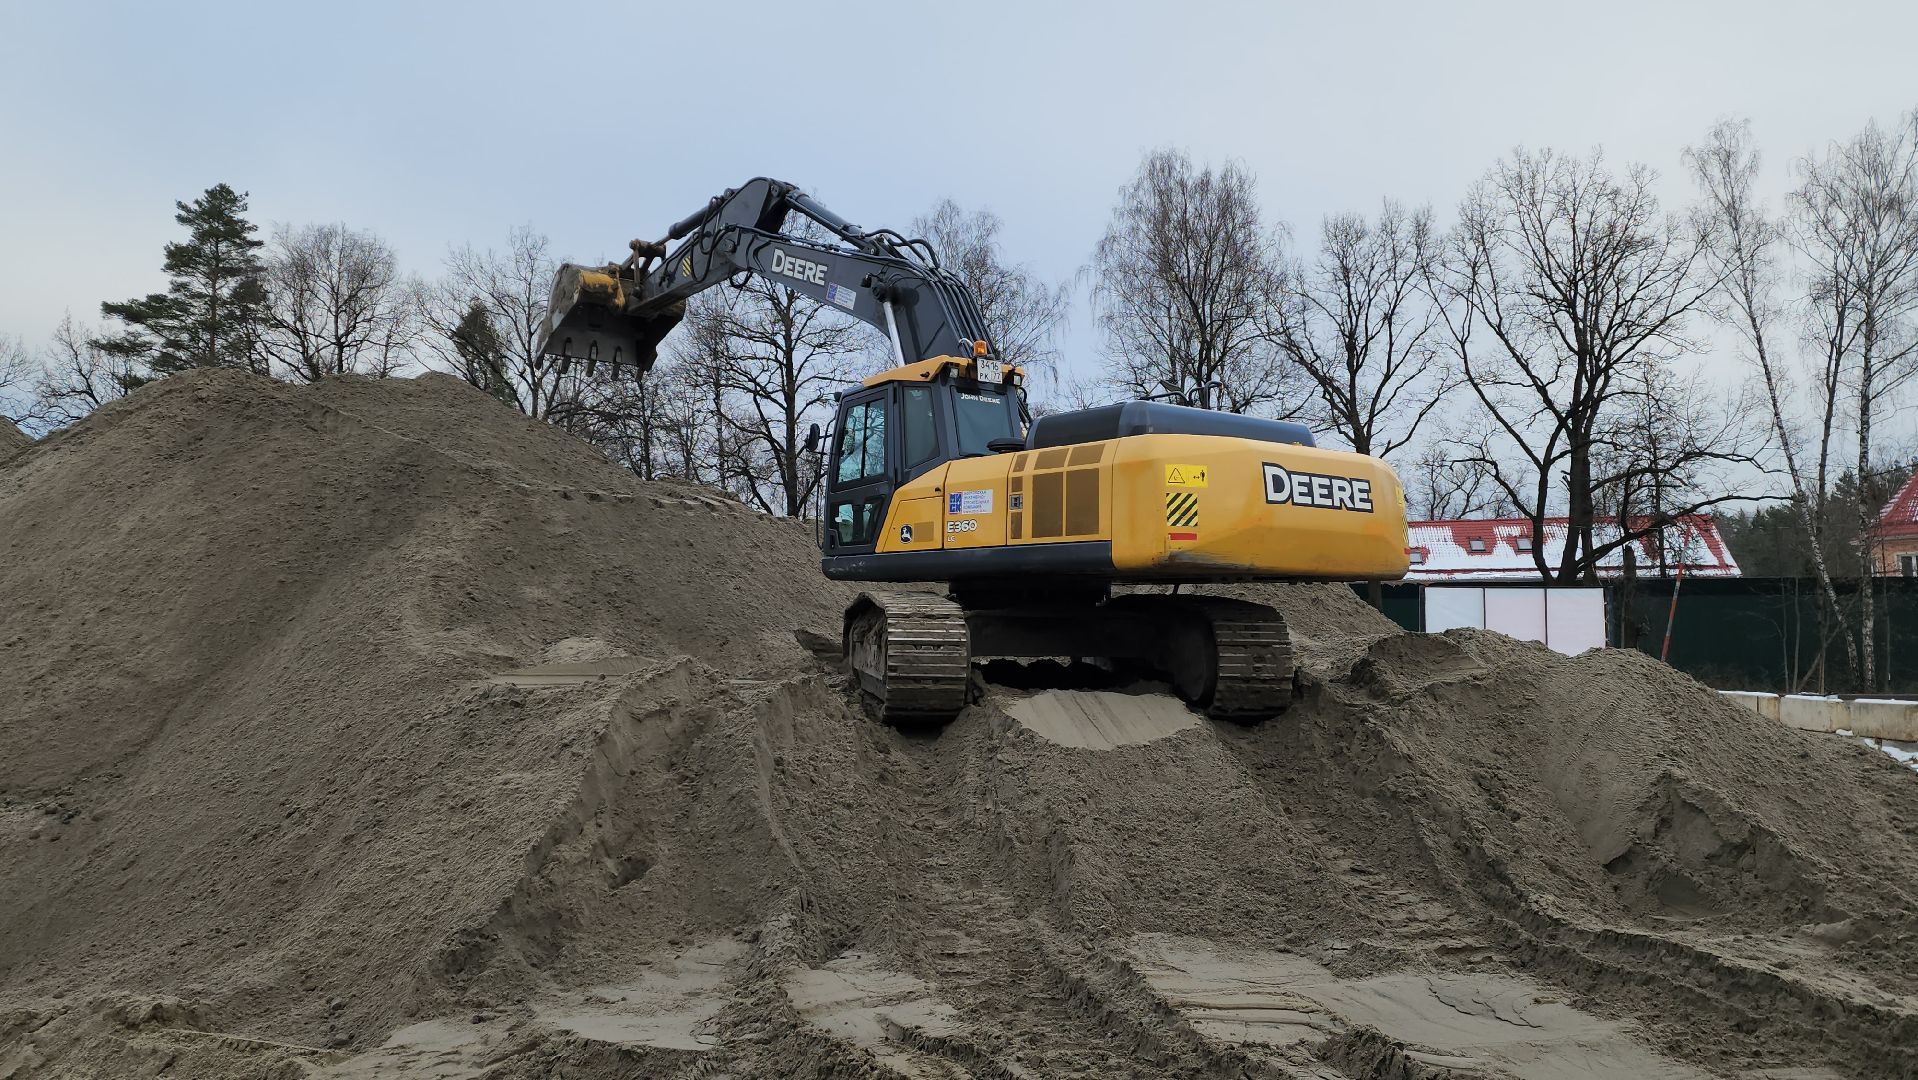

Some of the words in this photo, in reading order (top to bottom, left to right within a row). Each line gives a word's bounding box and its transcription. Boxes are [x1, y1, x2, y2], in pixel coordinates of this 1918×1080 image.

[771, 248, 828, 286] DEERE
[961, 393, 978, 401] JOHN
[979, 395, 1001, 404] DEERE
[1262, 463, 1373, 512] DEERE
[947, 519, 977, 533] E360
